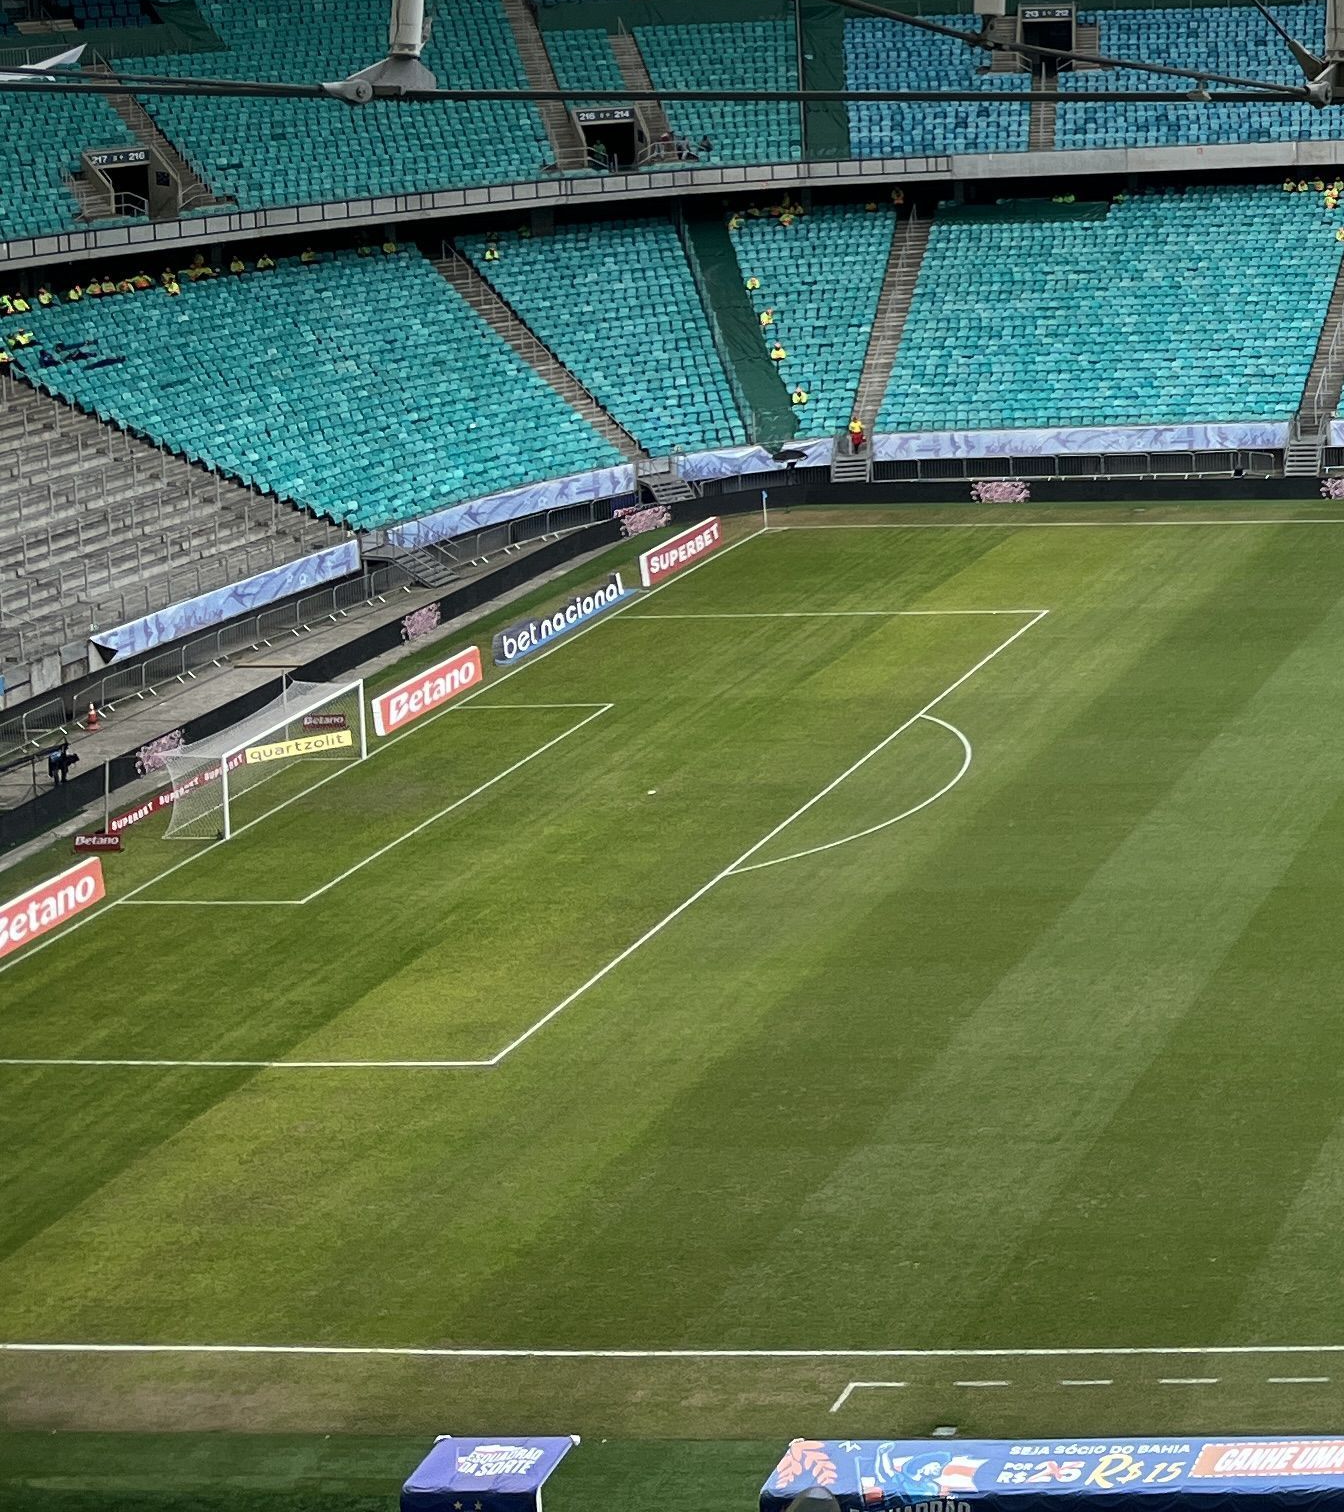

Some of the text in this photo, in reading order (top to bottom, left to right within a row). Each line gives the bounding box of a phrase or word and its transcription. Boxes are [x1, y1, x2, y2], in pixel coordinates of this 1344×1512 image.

[614, 110, 629, 119] 214
[92, 155, 108, 165] 217
[649, 523, 719, 574] SUPERBET
[390, 661, 475, 725] Betano
[250, 734, 345, 761] quartzolit
[112, 802, 153, 831] SUPERBET
[75, 836, 119, 846] Betano
[468, 1446, 544, 1462] ESQUADRÃO
[1009, 1443, 1190, 1456] SEJA SÓCIO DO BAHIA
[1216, 1447, 1296, 1472] GANHE
[1291, 1445, 1344, 1469] UMA
[475, 1460, 534, 1477] SORTE
[1005, 1463, 1033, 1472] POR
[1085, 1453, 1186, 1489] R$ 15
[997, 1472, 1027, 1485] R$
